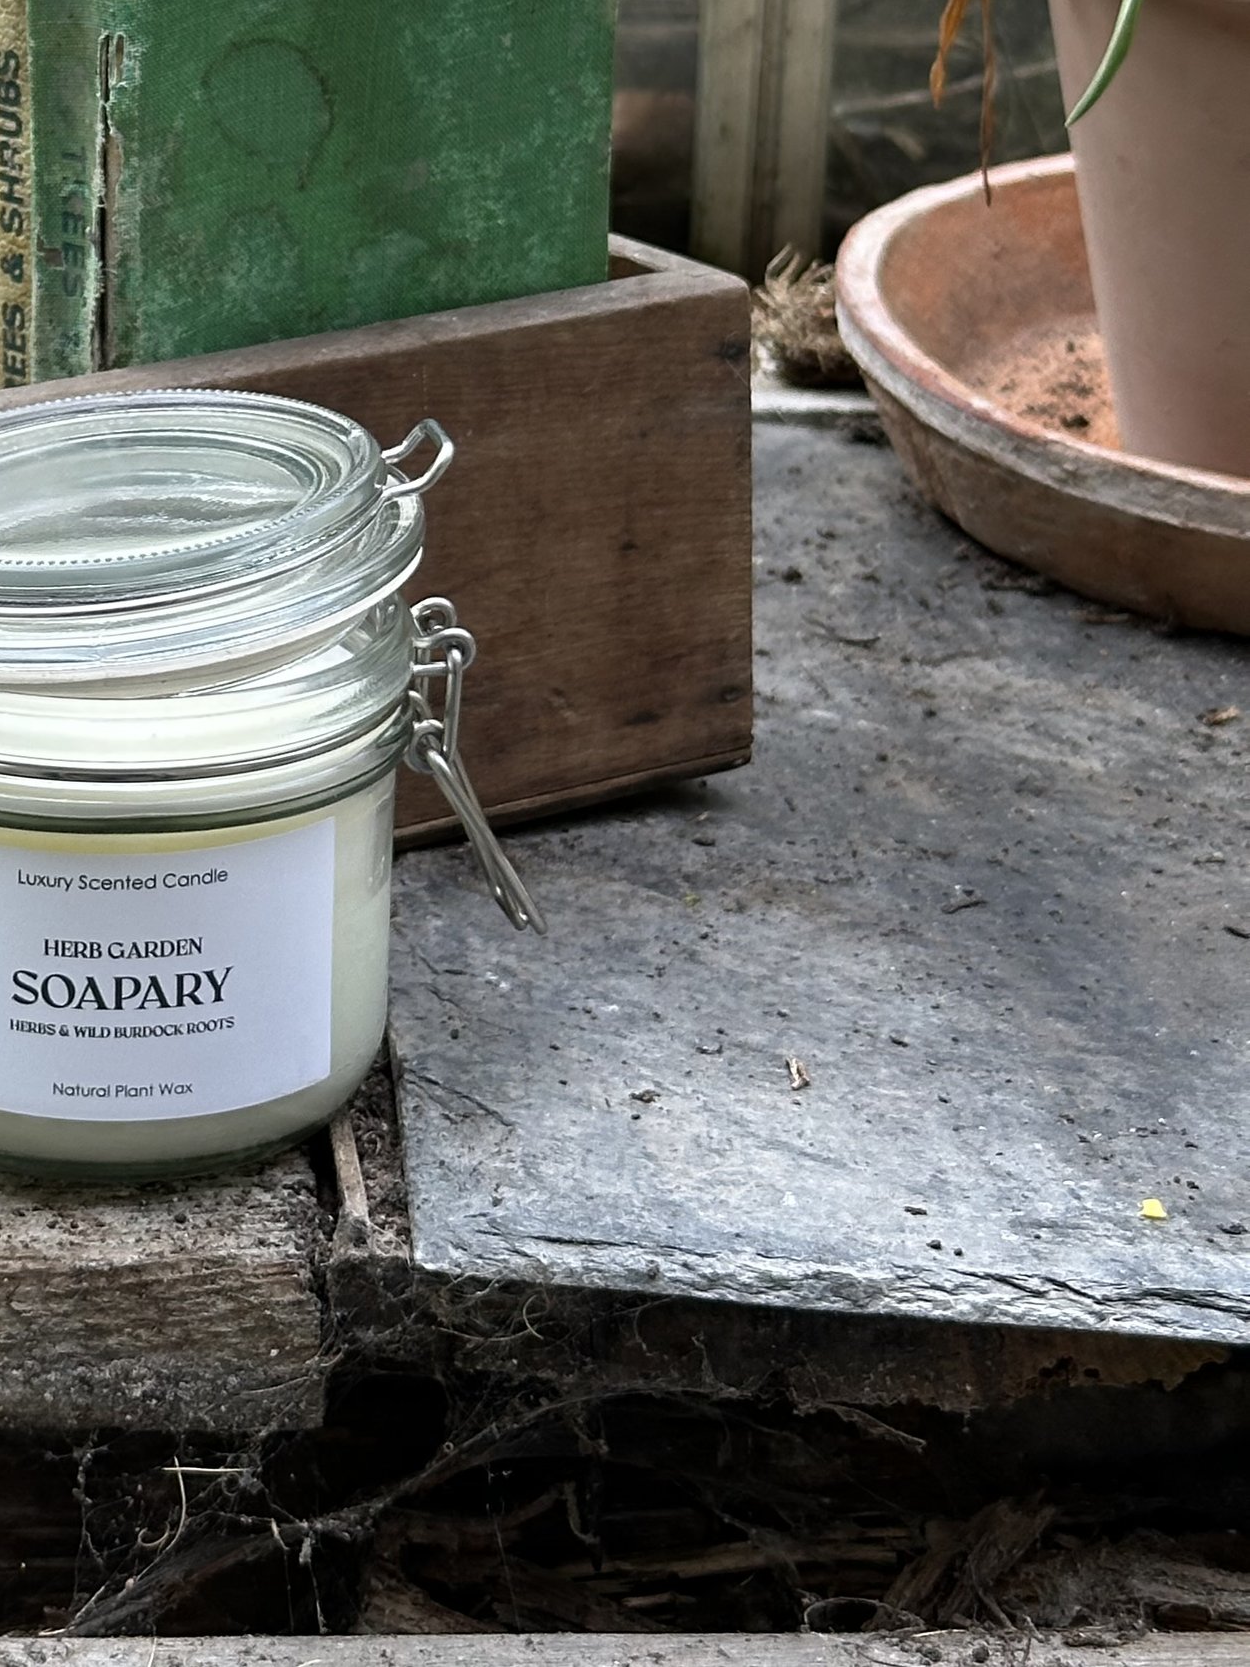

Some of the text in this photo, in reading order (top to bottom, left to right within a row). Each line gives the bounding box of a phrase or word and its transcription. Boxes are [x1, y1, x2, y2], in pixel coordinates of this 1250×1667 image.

[1, 253, 25, 285] &
[1, 302, 26, 389] EES
[17, 868, 229, 892] Luxury Scented Candle
[43, 936, 204, 959] HERB GARDEN
[11, 966, 234, 1011] SOAPARY
[10, 1016, 235, 1039] HERBS & WILD BURDOCK ROOTS
[53, 1081, 193, 1098] Natural Plant Wax
